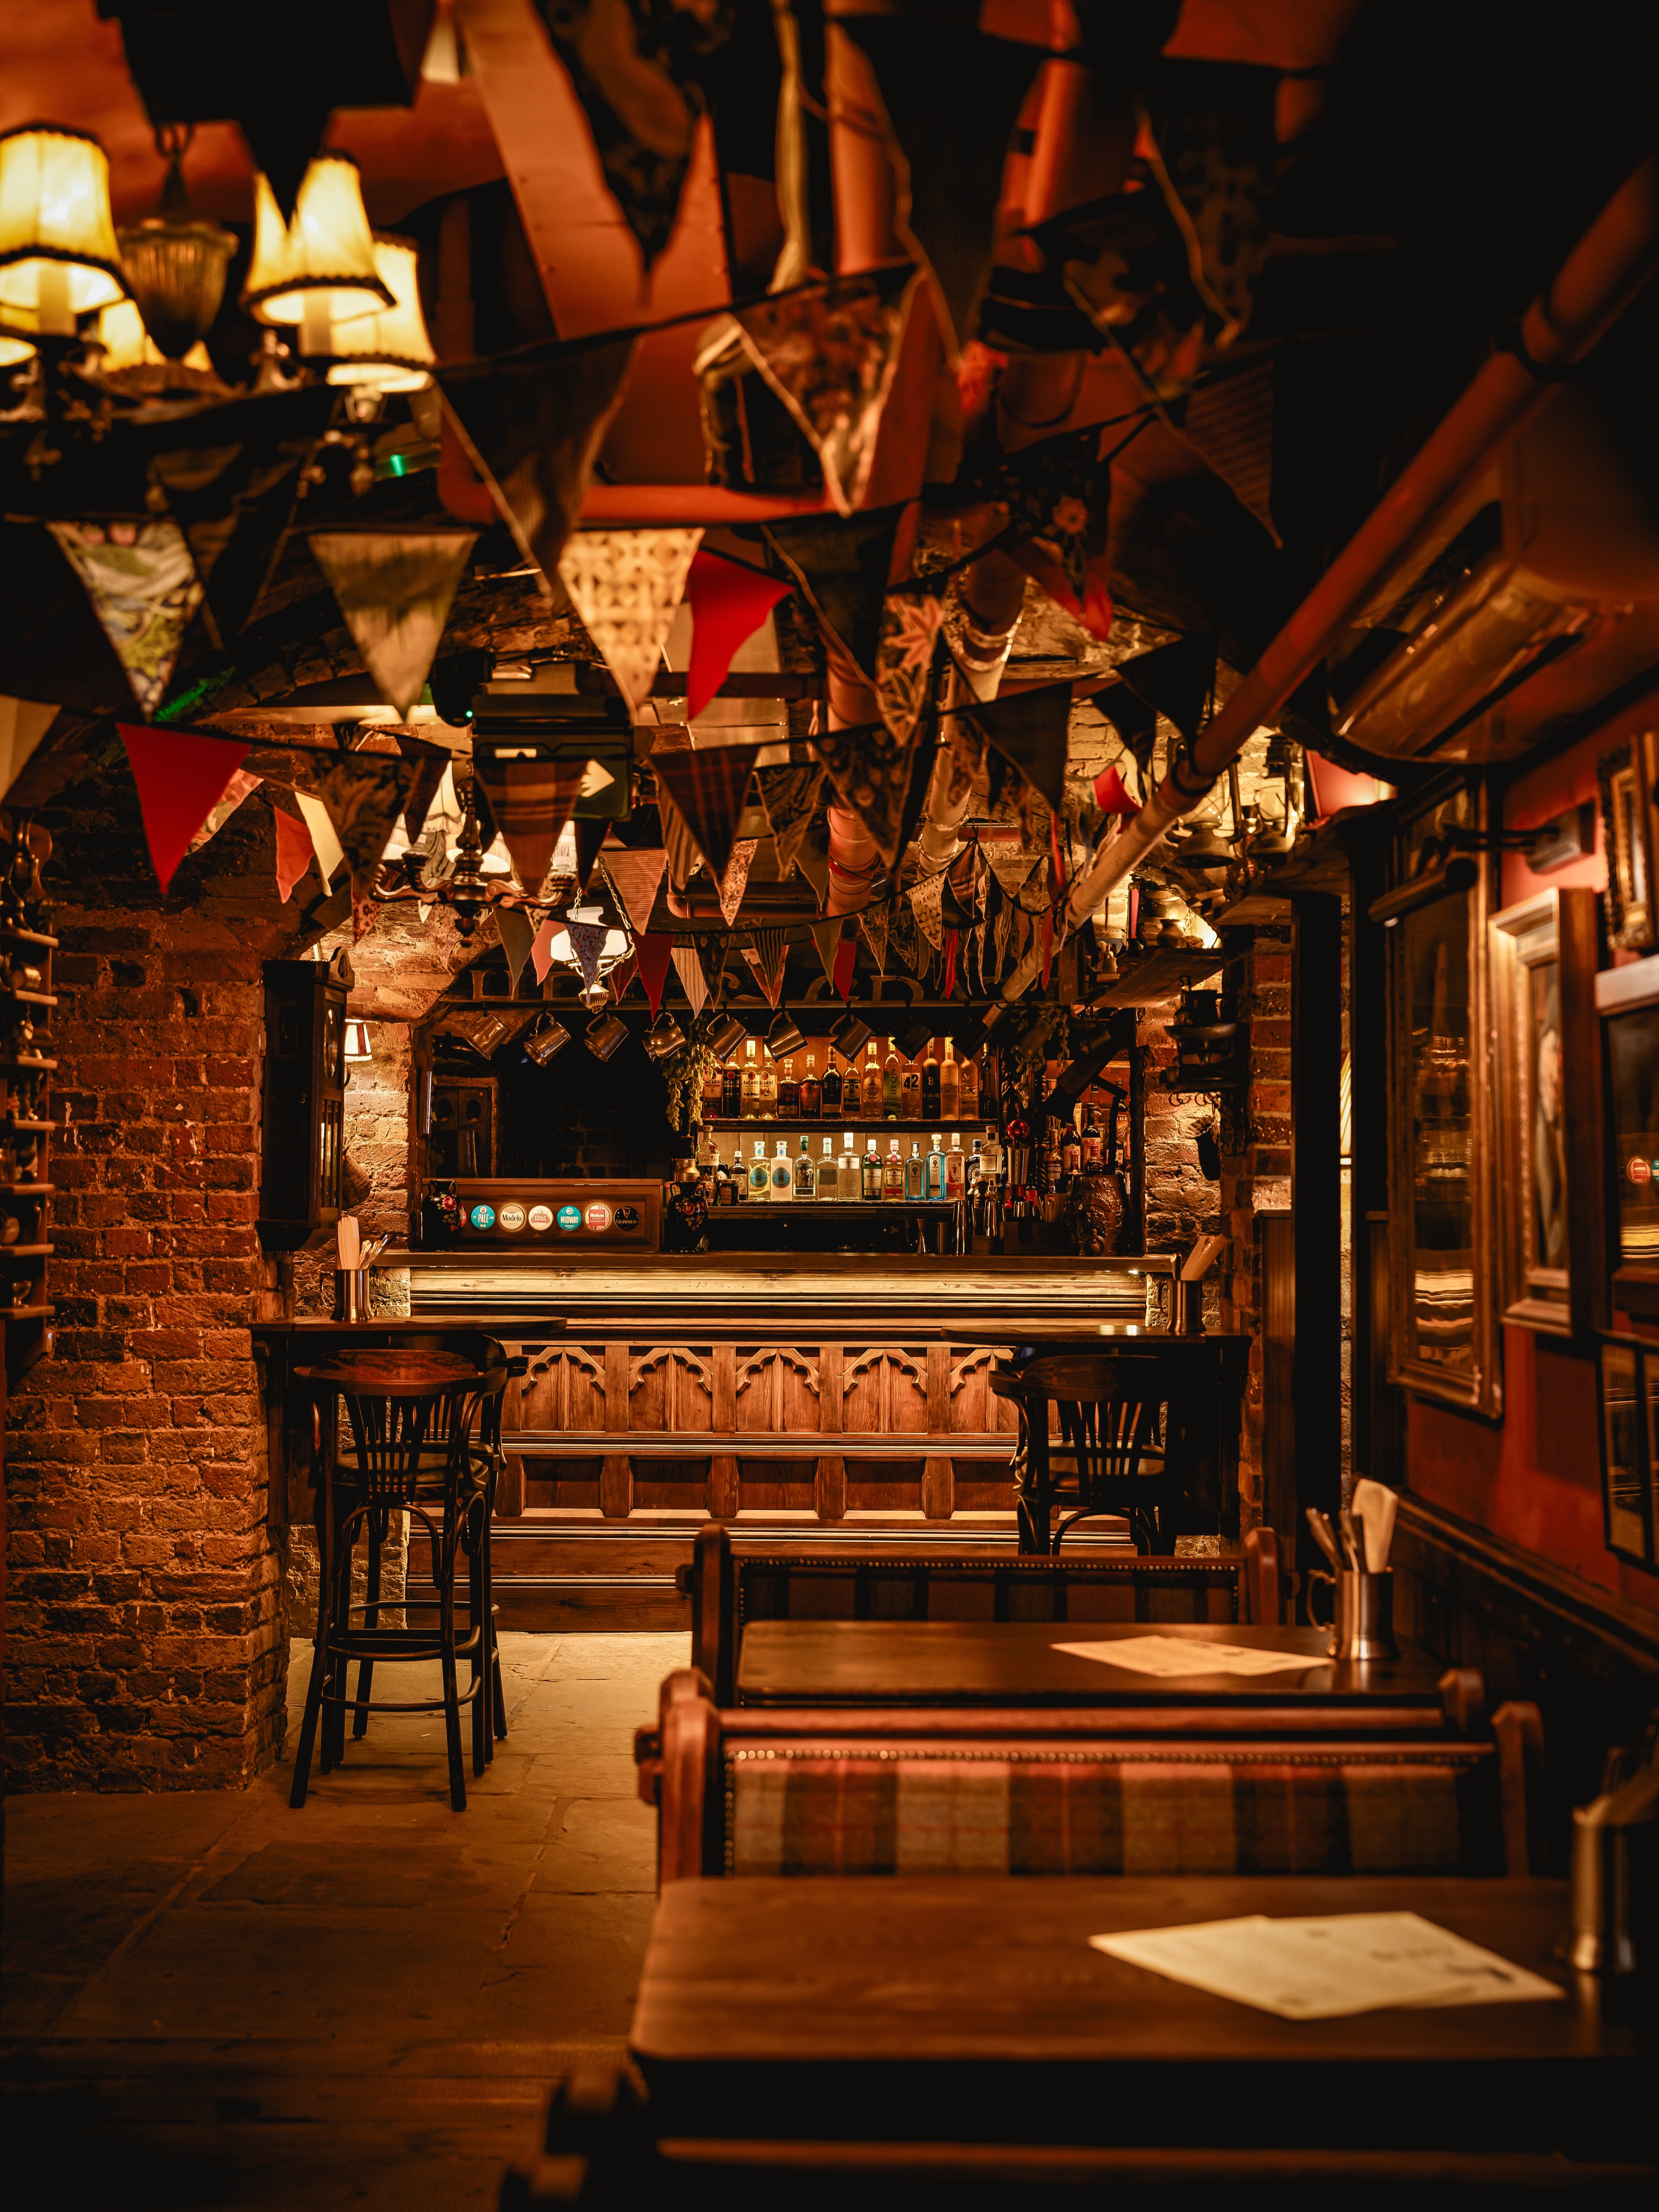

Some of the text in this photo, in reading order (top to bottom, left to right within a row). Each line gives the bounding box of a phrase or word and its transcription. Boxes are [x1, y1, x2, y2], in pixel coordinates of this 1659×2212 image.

[903, 1074, 919, 1089] 42
[928, 1076, 934, 1085] B
[968, 1164, 979, 1179] PLYMOUTH
[478, 1213, 489, 1223] PALE
